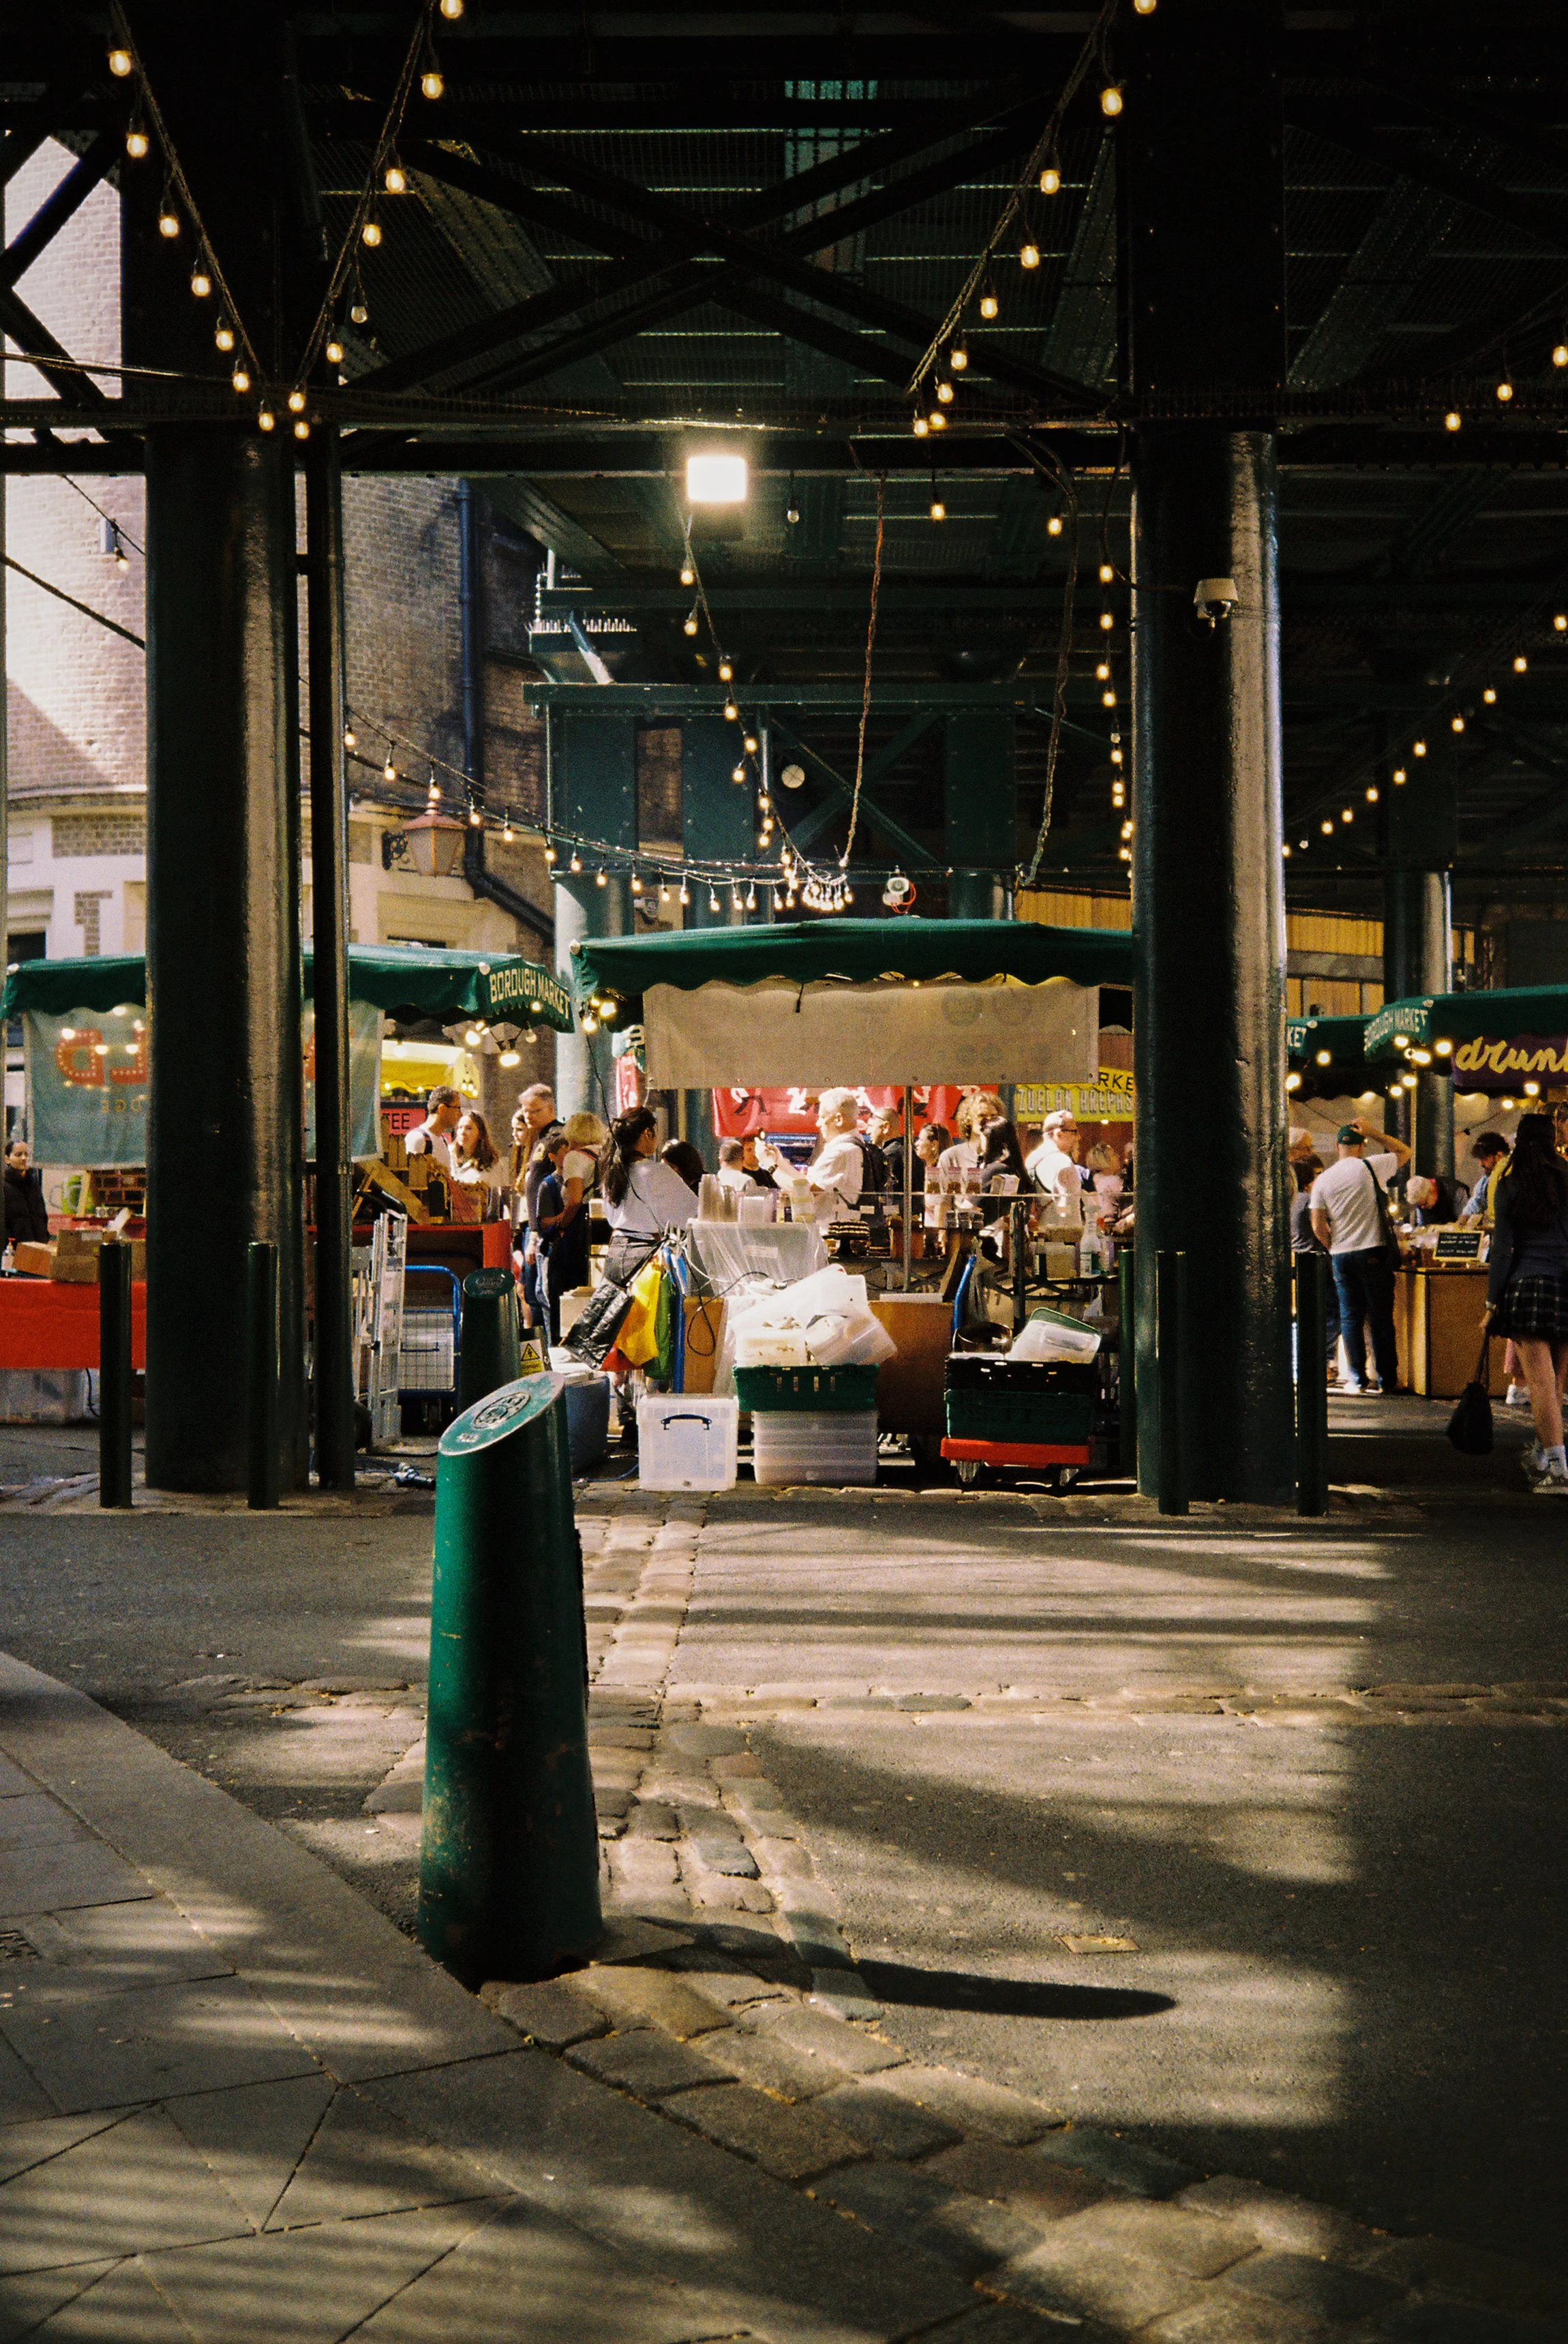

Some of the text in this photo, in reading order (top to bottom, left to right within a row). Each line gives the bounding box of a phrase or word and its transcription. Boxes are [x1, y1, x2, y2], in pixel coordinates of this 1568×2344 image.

[489, 968, 571, 1020] BOROUGH MARKET
[1455, 1036, 1568, 1073] drun
